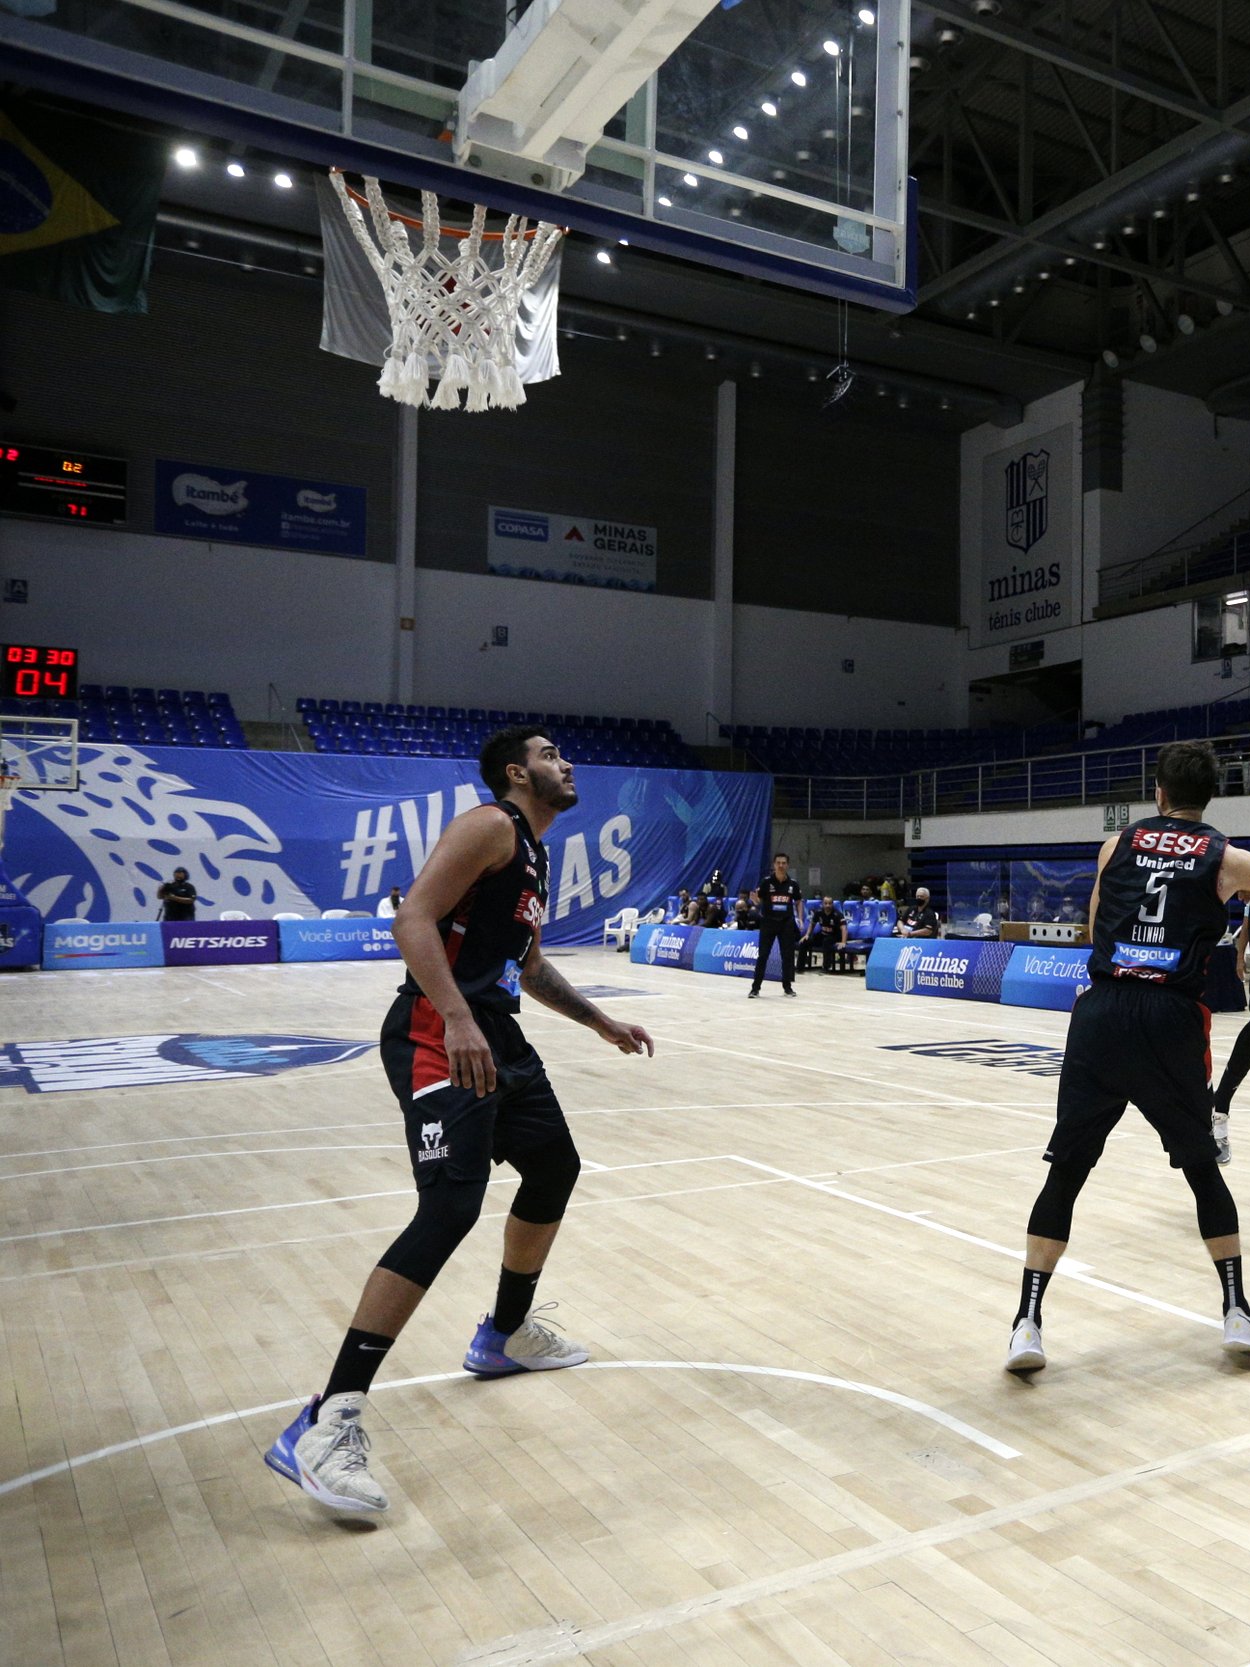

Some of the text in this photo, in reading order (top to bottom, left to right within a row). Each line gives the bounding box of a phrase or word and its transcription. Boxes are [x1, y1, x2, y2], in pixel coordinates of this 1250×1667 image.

[186, 485, 239, 504] itambé
[497, 522, 546, 537] COPASA
[593, 524, 647, 542] MINAS
[593, 537, 655, 556] GERAIS
[12, 581, 25, 594] A
[988, 562, 1061, 602] minas
[1025, 599, 1061, 624] clube
[15, 668, 68, 697] 04
[1107, 806, 1115, 820] A
[1121, 806, 1128, 819] B
[1138, 831, 1201, 856] SESI
[1136, 854, 1195, 870] Unimed
[1138, 871, 1175, 924] 5
[54, 933, 147, 951] Magalu
[170, 936, 268, 949] NETSHOES
[299, 929, 332, 943] Você
[335, 931, 369, 942] curte
[659, 932, 685, 950] minas
[1131, 924, 1165, 944] ELINHO
[712, 941, 734, 958] Curto
[1119, 945, 1175, 962] Magalu
[918, 951, 969, 974] minas
[1024, 954, 1087, 979] Você curte
[917, 972, 964, 989] tênis clube
[417, 1145, 449, 1163] BASQUETE
